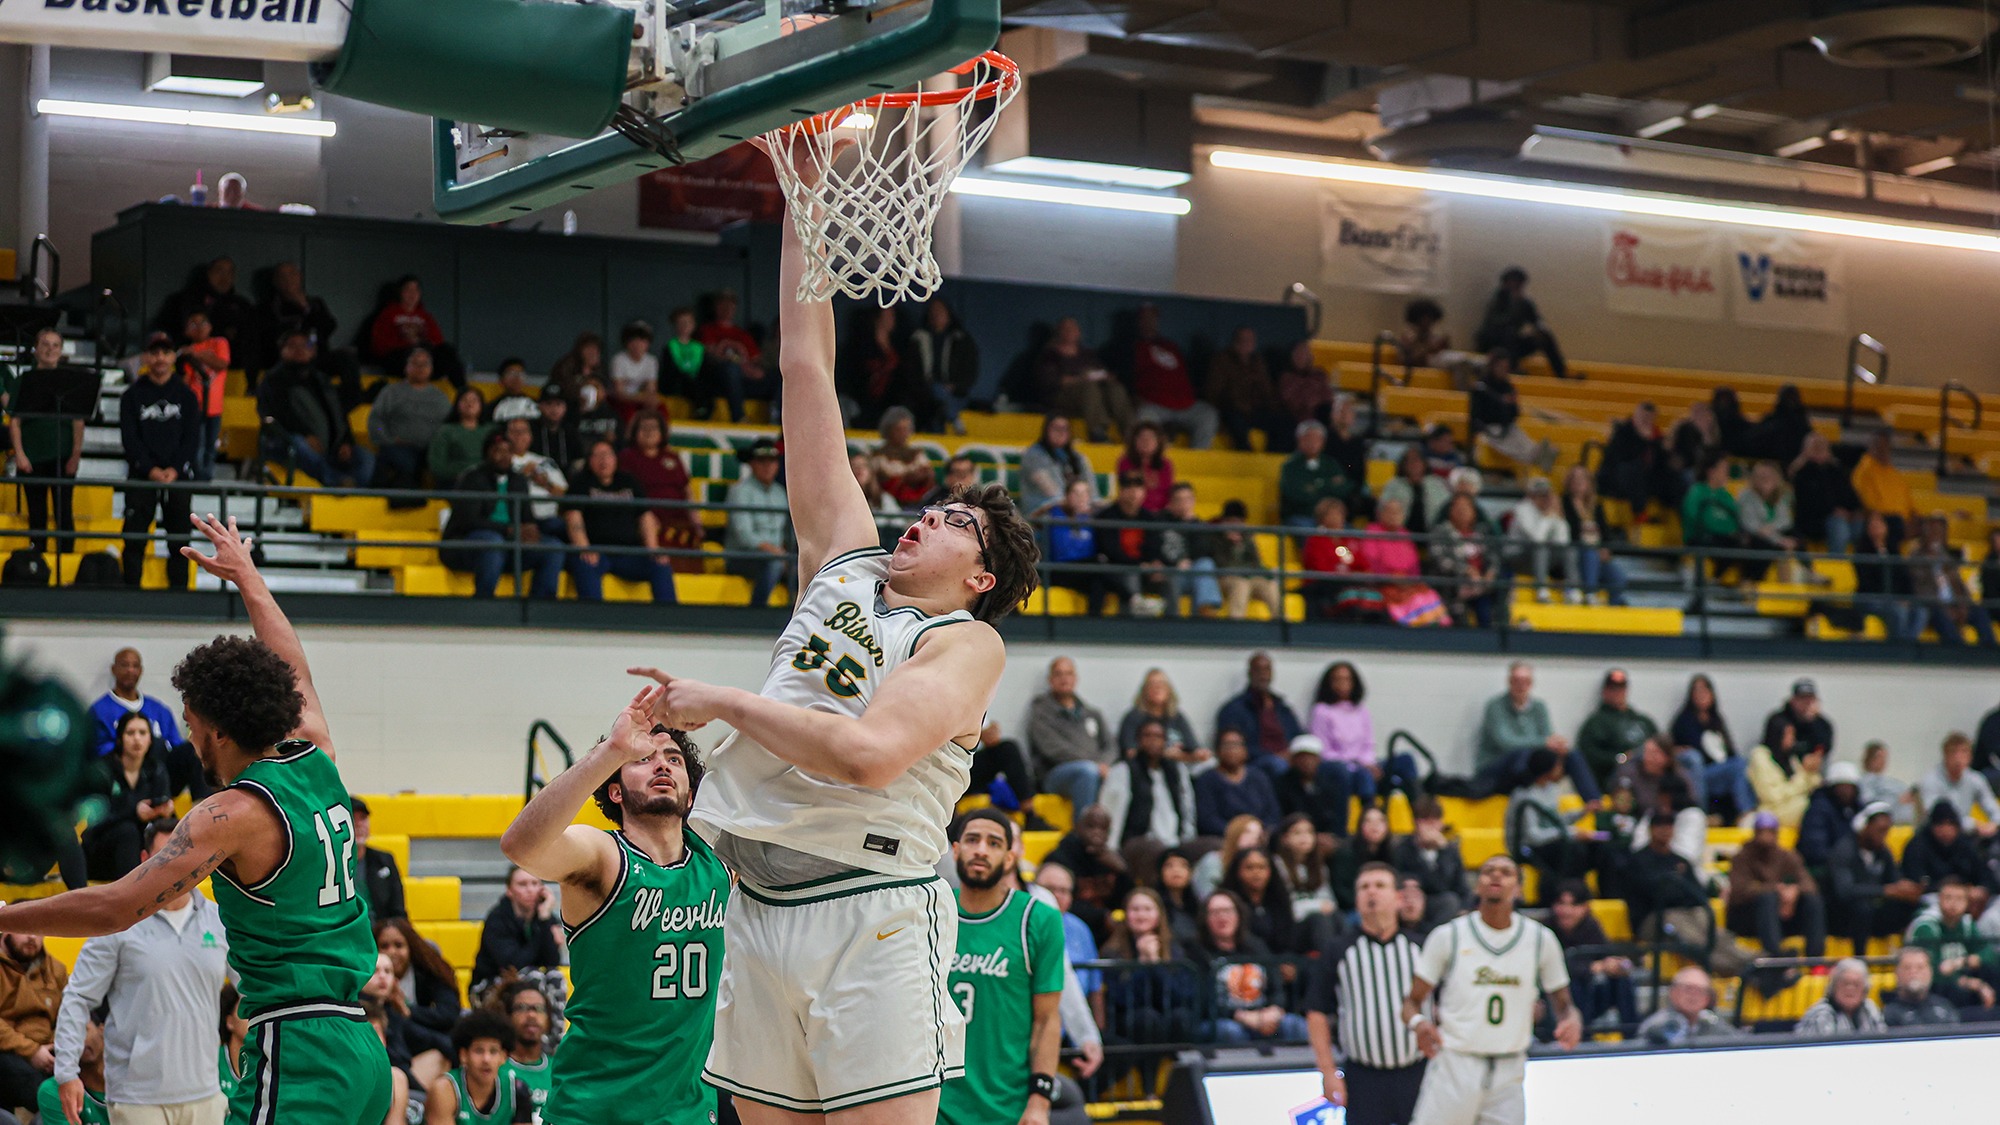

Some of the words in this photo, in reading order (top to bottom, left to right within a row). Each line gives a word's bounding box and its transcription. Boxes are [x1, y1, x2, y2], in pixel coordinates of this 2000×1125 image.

[824, 601, 884, 668] Bison
[313, 803, 356, 908] 12
[631, 887, 725, 932] Weevils
[651, 942, 708, 999] 20
[950, 946, 1009, 977] eevils
[953, 981, 976, 1025] 3
[1487, 992, 1505, 1026] 0
